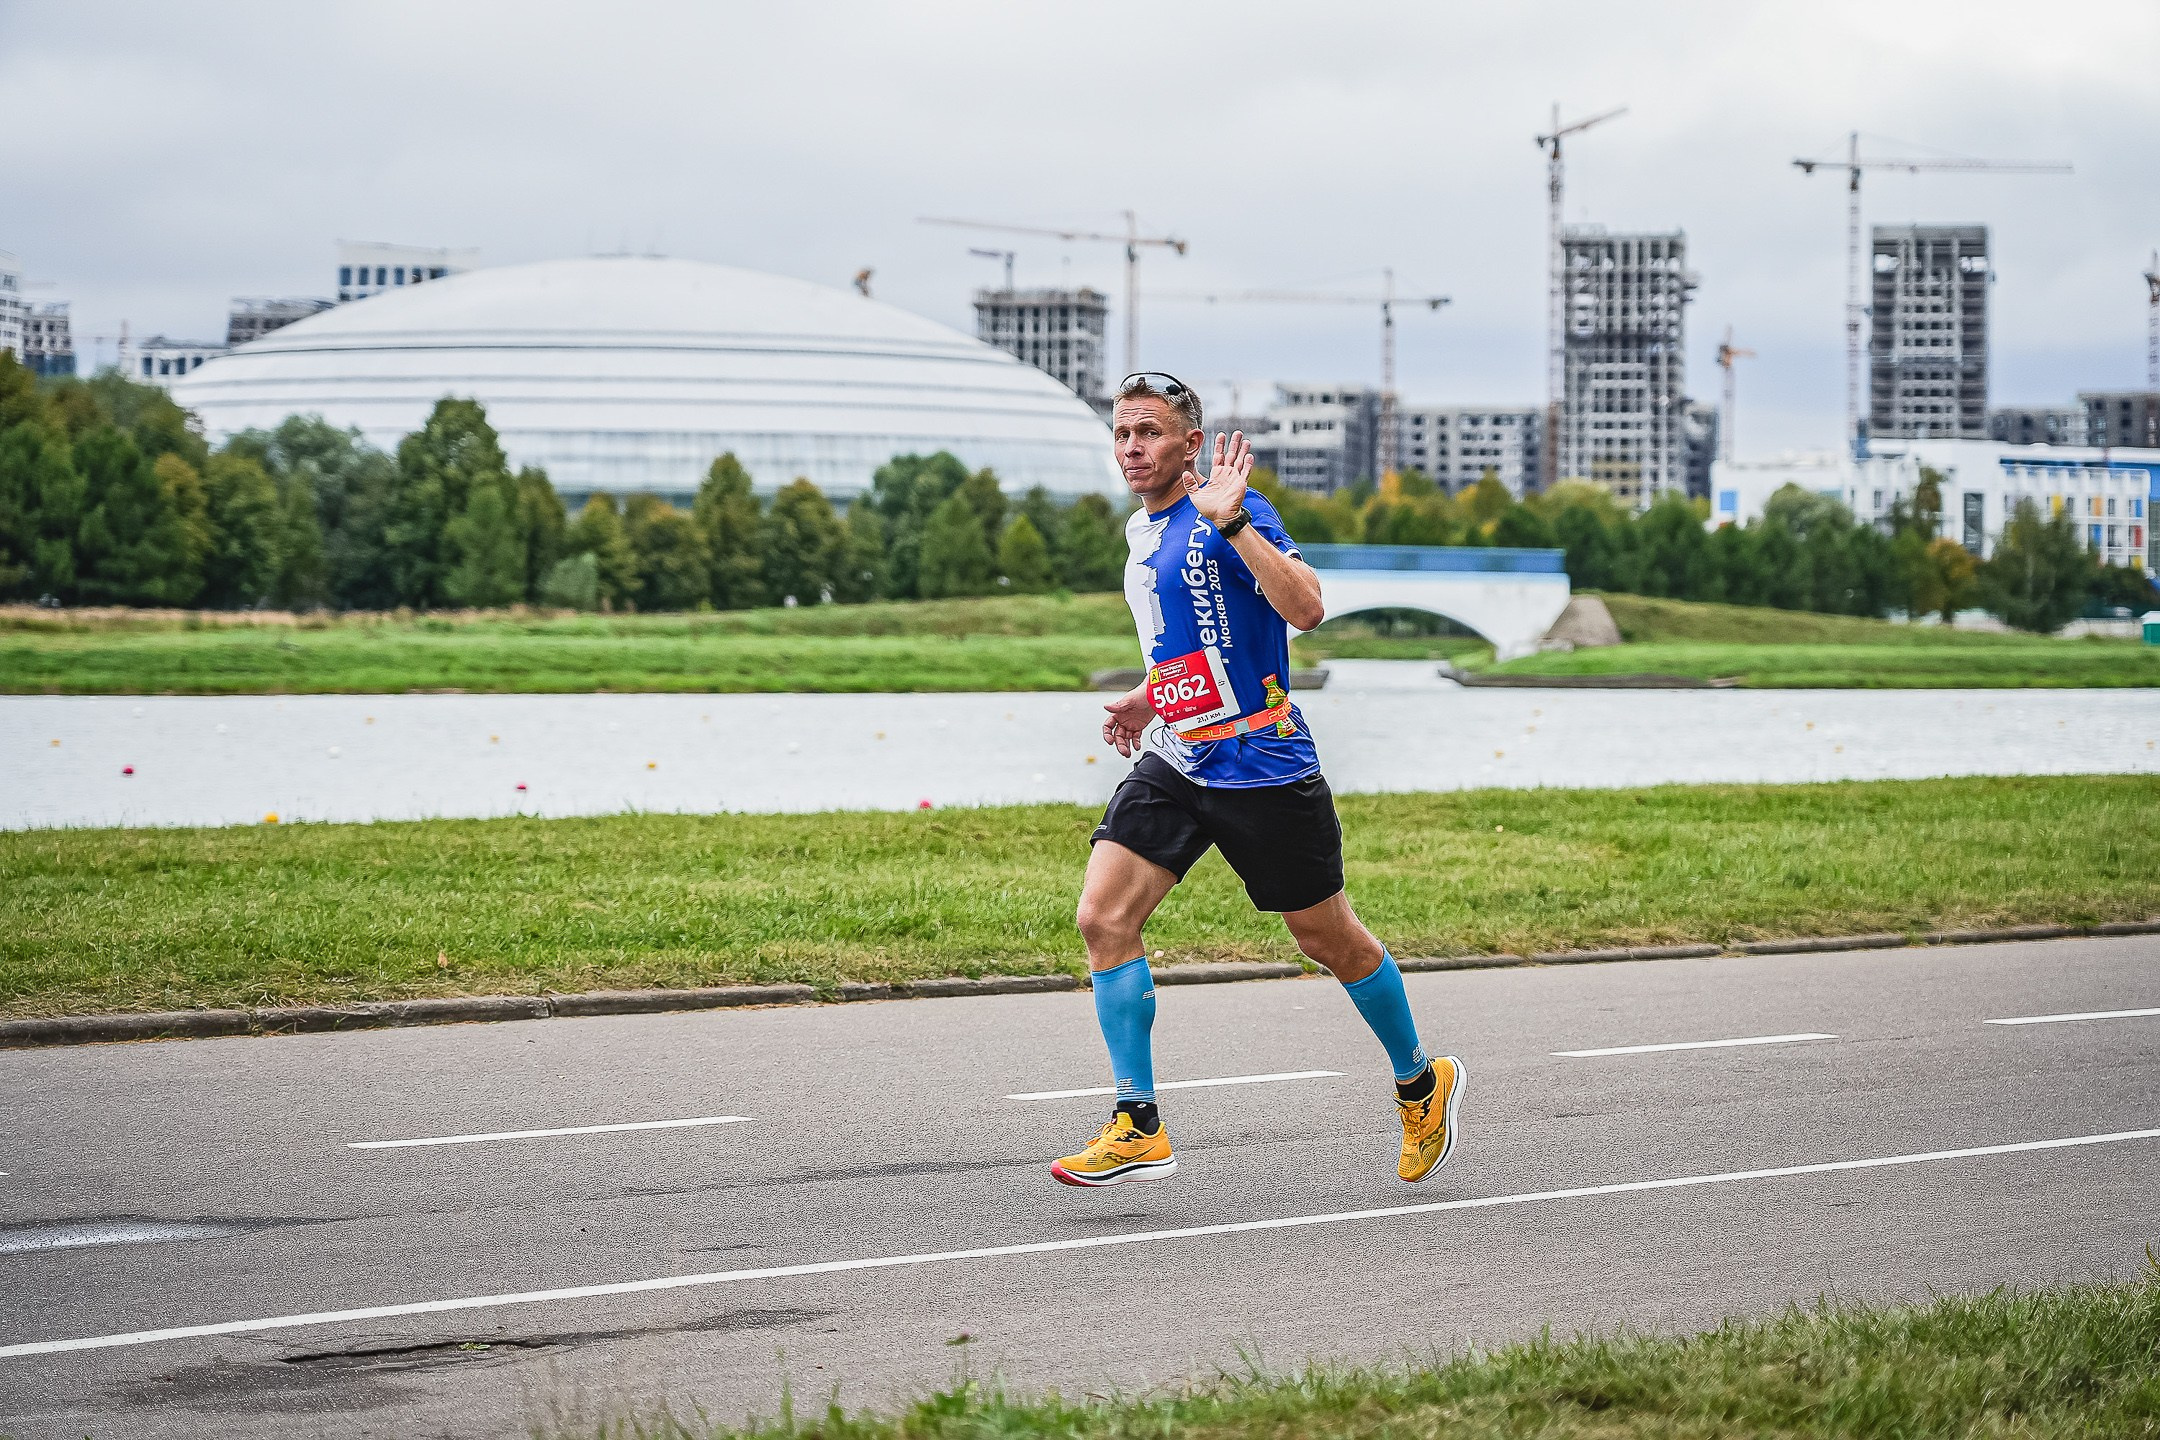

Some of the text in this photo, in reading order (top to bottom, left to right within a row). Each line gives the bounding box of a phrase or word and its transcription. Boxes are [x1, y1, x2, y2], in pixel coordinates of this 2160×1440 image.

[1181, 512, 1230, 664] екибегу
[1206, 559, 1233, 648] Москва 2023
[1152, 674, 1211, 709] 5062
[1180, 726, 1233, 738] WERUP
[1196, 714, 1209, 724] 21,1
